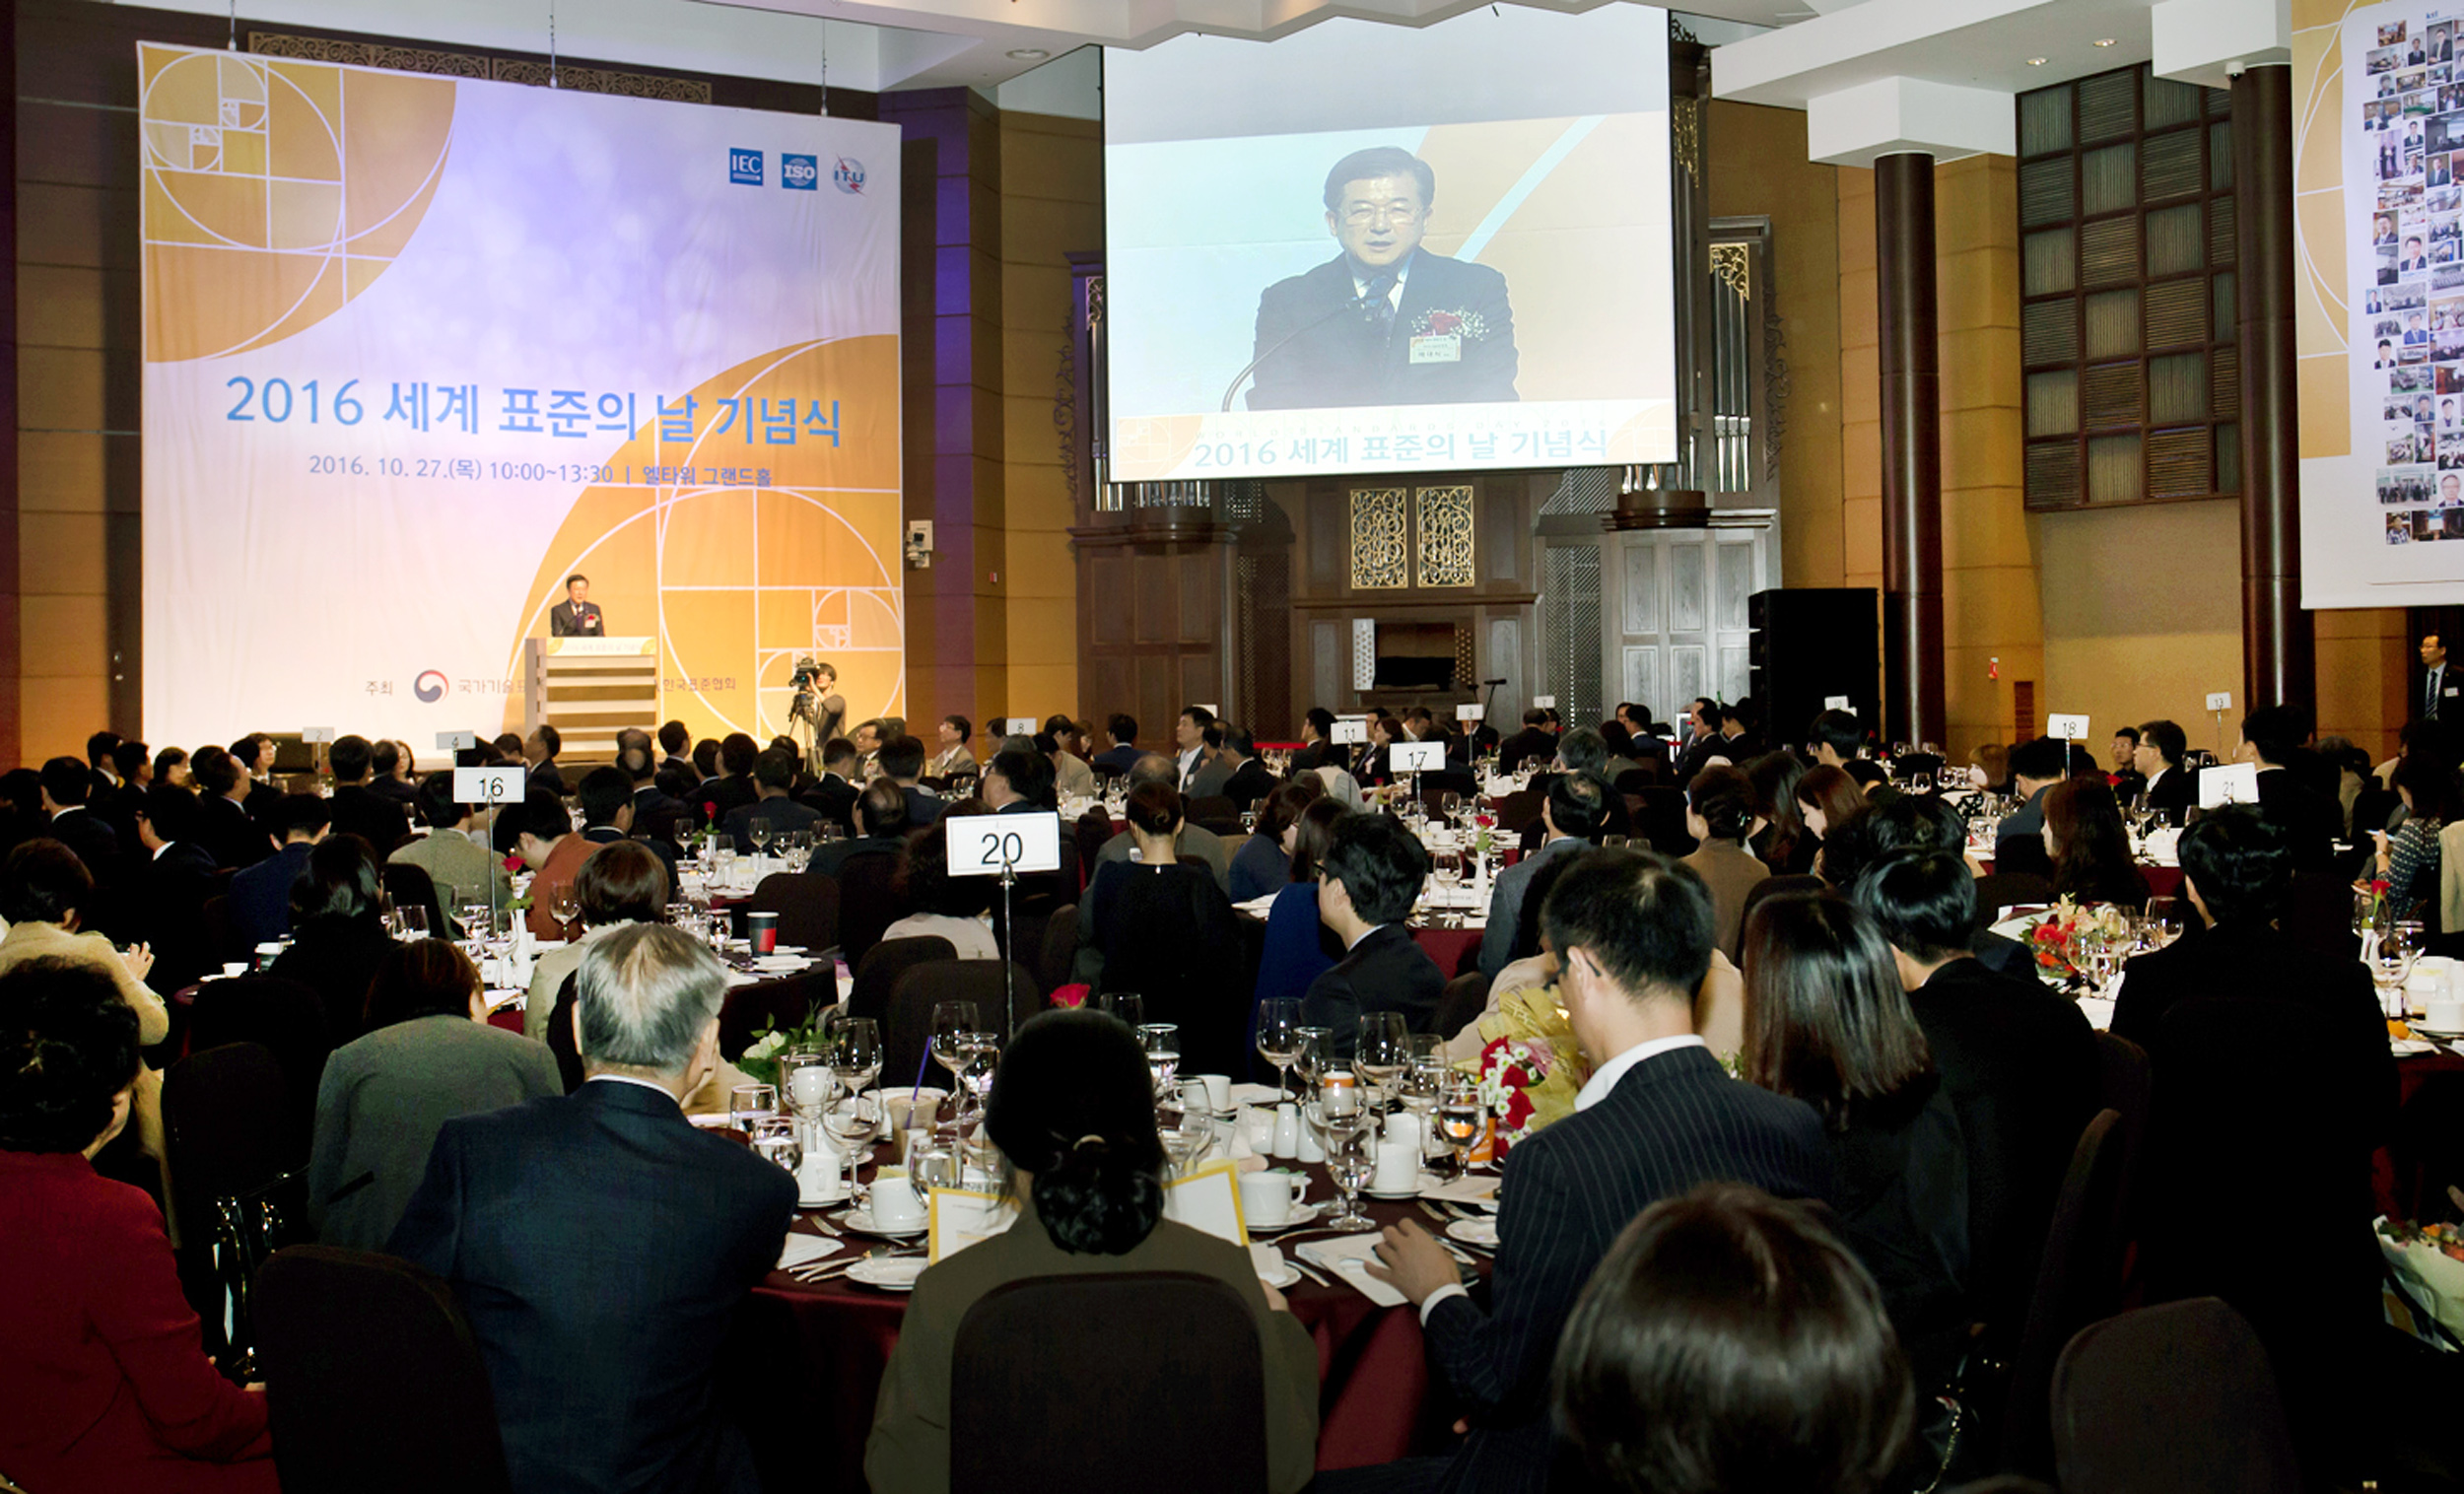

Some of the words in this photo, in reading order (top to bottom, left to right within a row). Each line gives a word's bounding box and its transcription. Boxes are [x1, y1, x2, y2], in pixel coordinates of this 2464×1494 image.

[732, 155, 761, 174] IEC
[784, 164, 816, 179] ISO
[834, 170, 864, 183] ITU
[226, 375, 364, 426] 2016
[382, 381, 479, 435] 세계
[499, 388, 636, 441] 표준의
[656, 394, 699, 443] 날
[716, 396, 840, 448] 기념식
[1195, 439, 1278, 467] 2016
[1287, 437, 1349, 465] 세계
[1360, 432, 1455, 462] 표준의
[1468, 431, 1499, 460] 날
[1511, 429, 1608, 458] 기념식
[308, 454, 370, 476] 2016.
[377, 457, 409, 478] 10.
[415, 457, 482, 481] 27.(목)
[489, 461, 614, 485] 10:00~13:30
[643, 465, 696, 487] 엘타워
[703, 467, 773, 489] 그랜드홀
[365, 680, 393, 697] 주최
[316, 729, 323, 740] 2
[1343, 727, 1355, 740] 11
[2063, 721, 2077, 736] 18
[1408, 751, 1428, 767] 17
[478, 777, 504, 797] 16
[2223, 781, 2234, 796] 21
[981, 832, 1023, 865] 20
